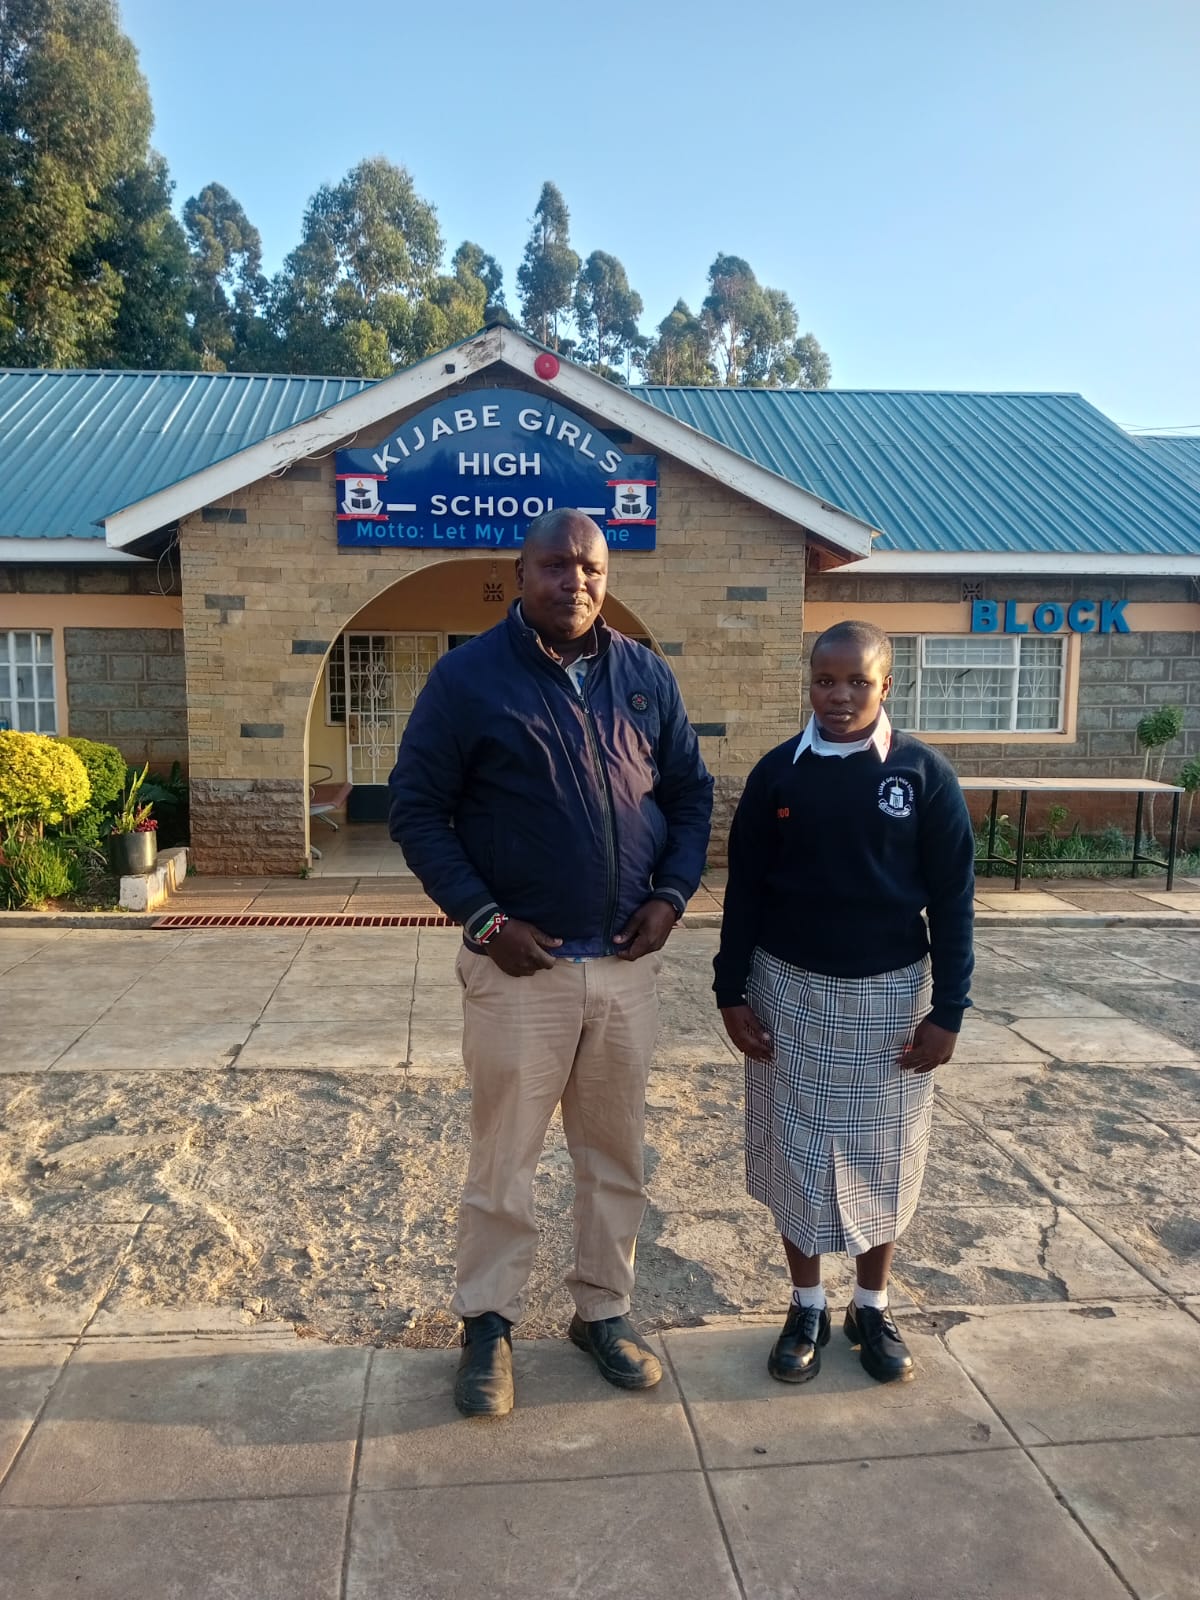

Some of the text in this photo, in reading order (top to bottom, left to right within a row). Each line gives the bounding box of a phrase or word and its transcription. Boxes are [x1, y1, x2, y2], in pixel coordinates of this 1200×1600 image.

[372, 405, 622, 474] KIJABE GIRLS
[459, 452, 541, 476] HIGH
[356, 521, 424, 539] Motto:
[433, 523, 466, 540] Let
[475, 524, 505, 544] My
[971, 599, 1130, 633] BLOCK
